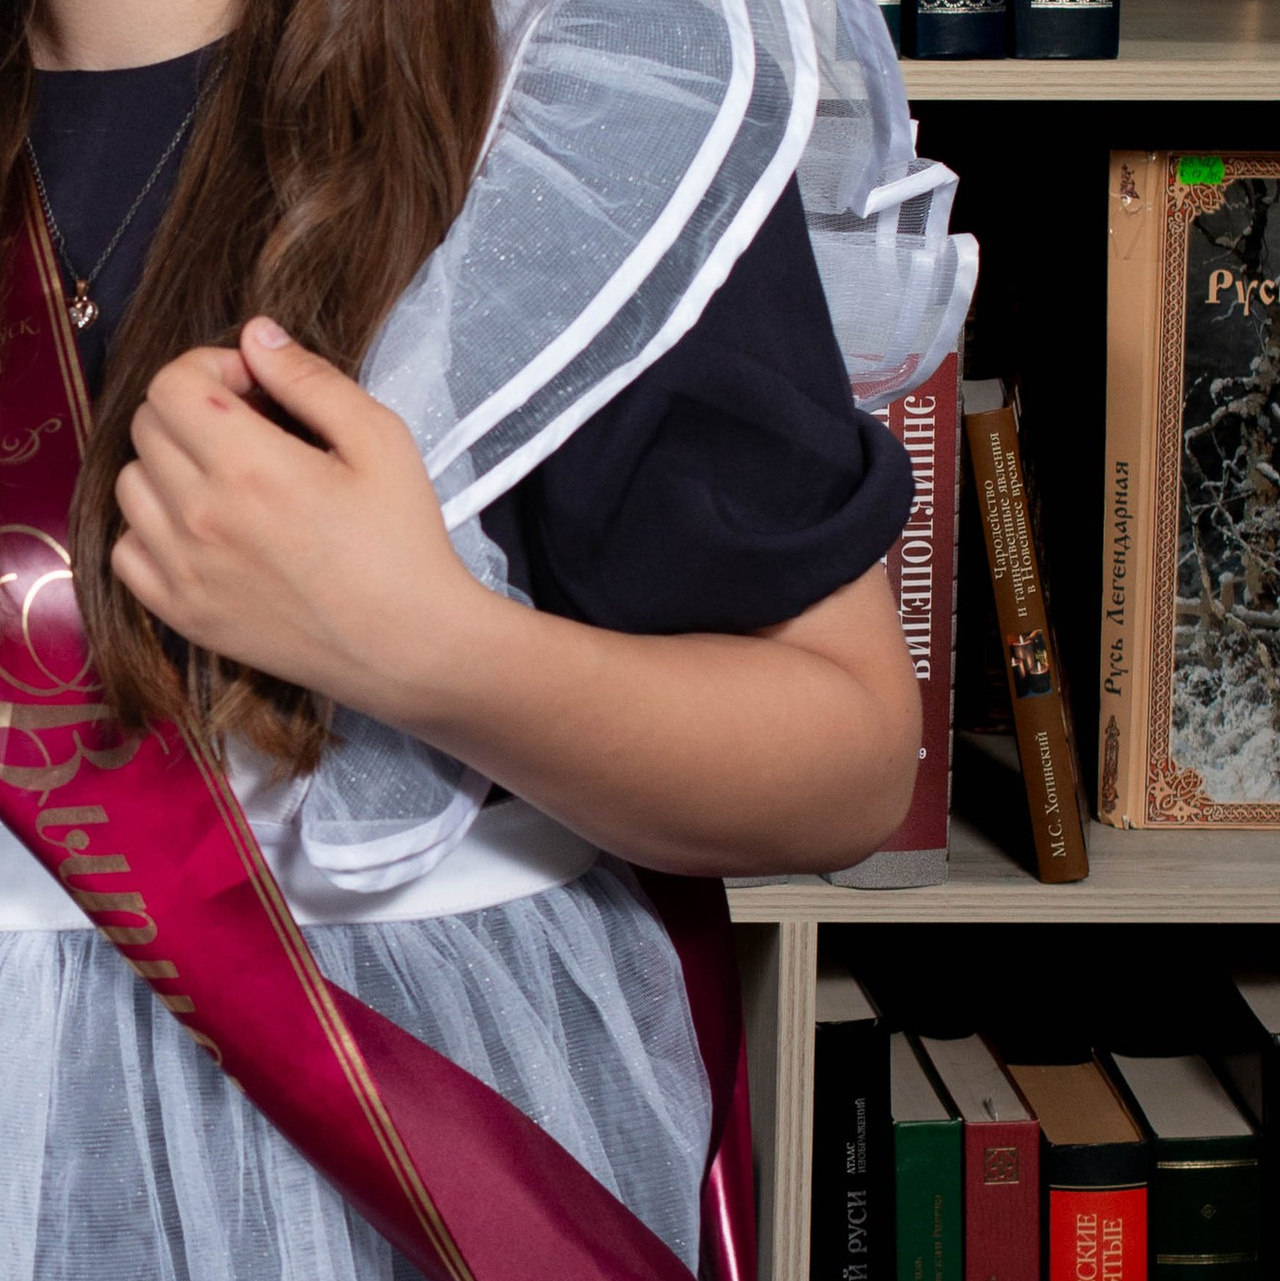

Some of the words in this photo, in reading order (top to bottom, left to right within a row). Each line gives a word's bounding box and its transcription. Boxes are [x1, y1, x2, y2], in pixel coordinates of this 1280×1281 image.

[990, 431, 1008, 492] явления
[1006, 451, 1022, 497] время
[984, 479, 1008, 579] Чародейство
[1000, 497, 1026, 603] таинственные
[1014, 501, 1035, 579] Новейшее
[1106, 461, 1134, 626] Легендарная
[1018, 606, 1028, 617] и
[1027, 584, 1037, 593] в
[1104, 637, 1127, 696] Русь
[1035, 730, 1060, 814] Хотинский
[847, 1190, 868, 1253] РУСИ
